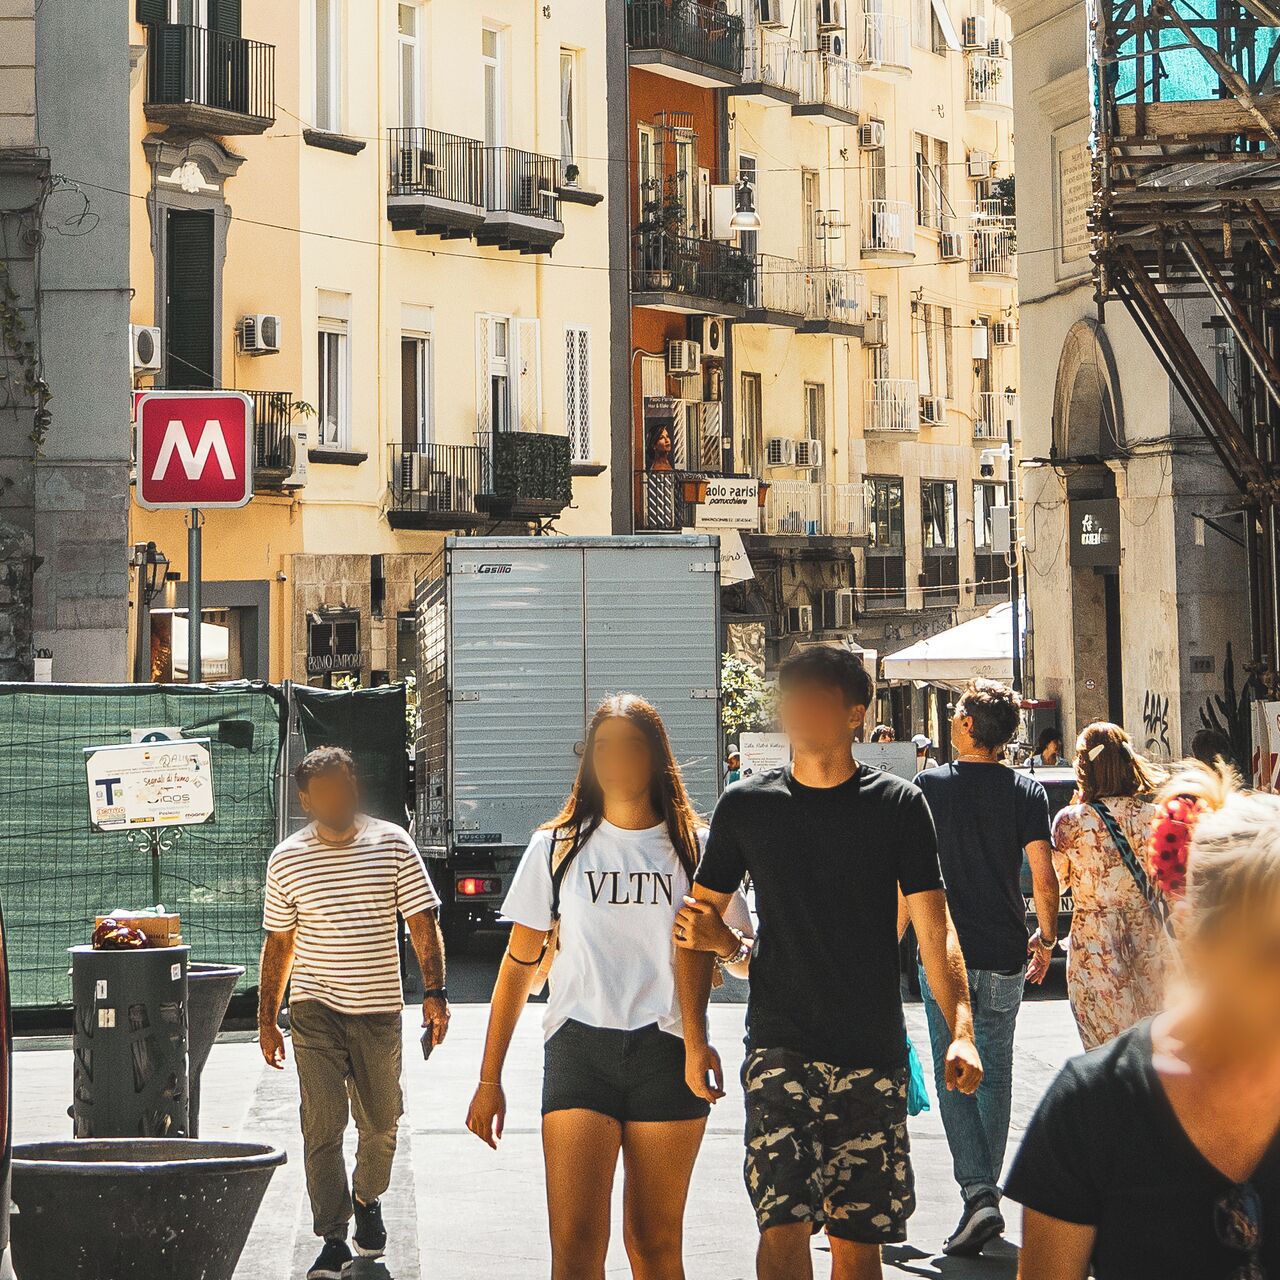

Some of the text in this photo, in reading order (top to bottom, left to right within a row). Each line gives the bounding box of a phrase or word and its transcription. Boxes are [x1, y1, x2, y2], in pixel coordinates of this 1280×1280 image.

[151, 419, 237, 481] M
[706, 485, 727, 496] aolo
[308, 654, 332, 670] PRIMO
[95, 777, 121, 806] T
[584, 870, 673, 906] VLTN
